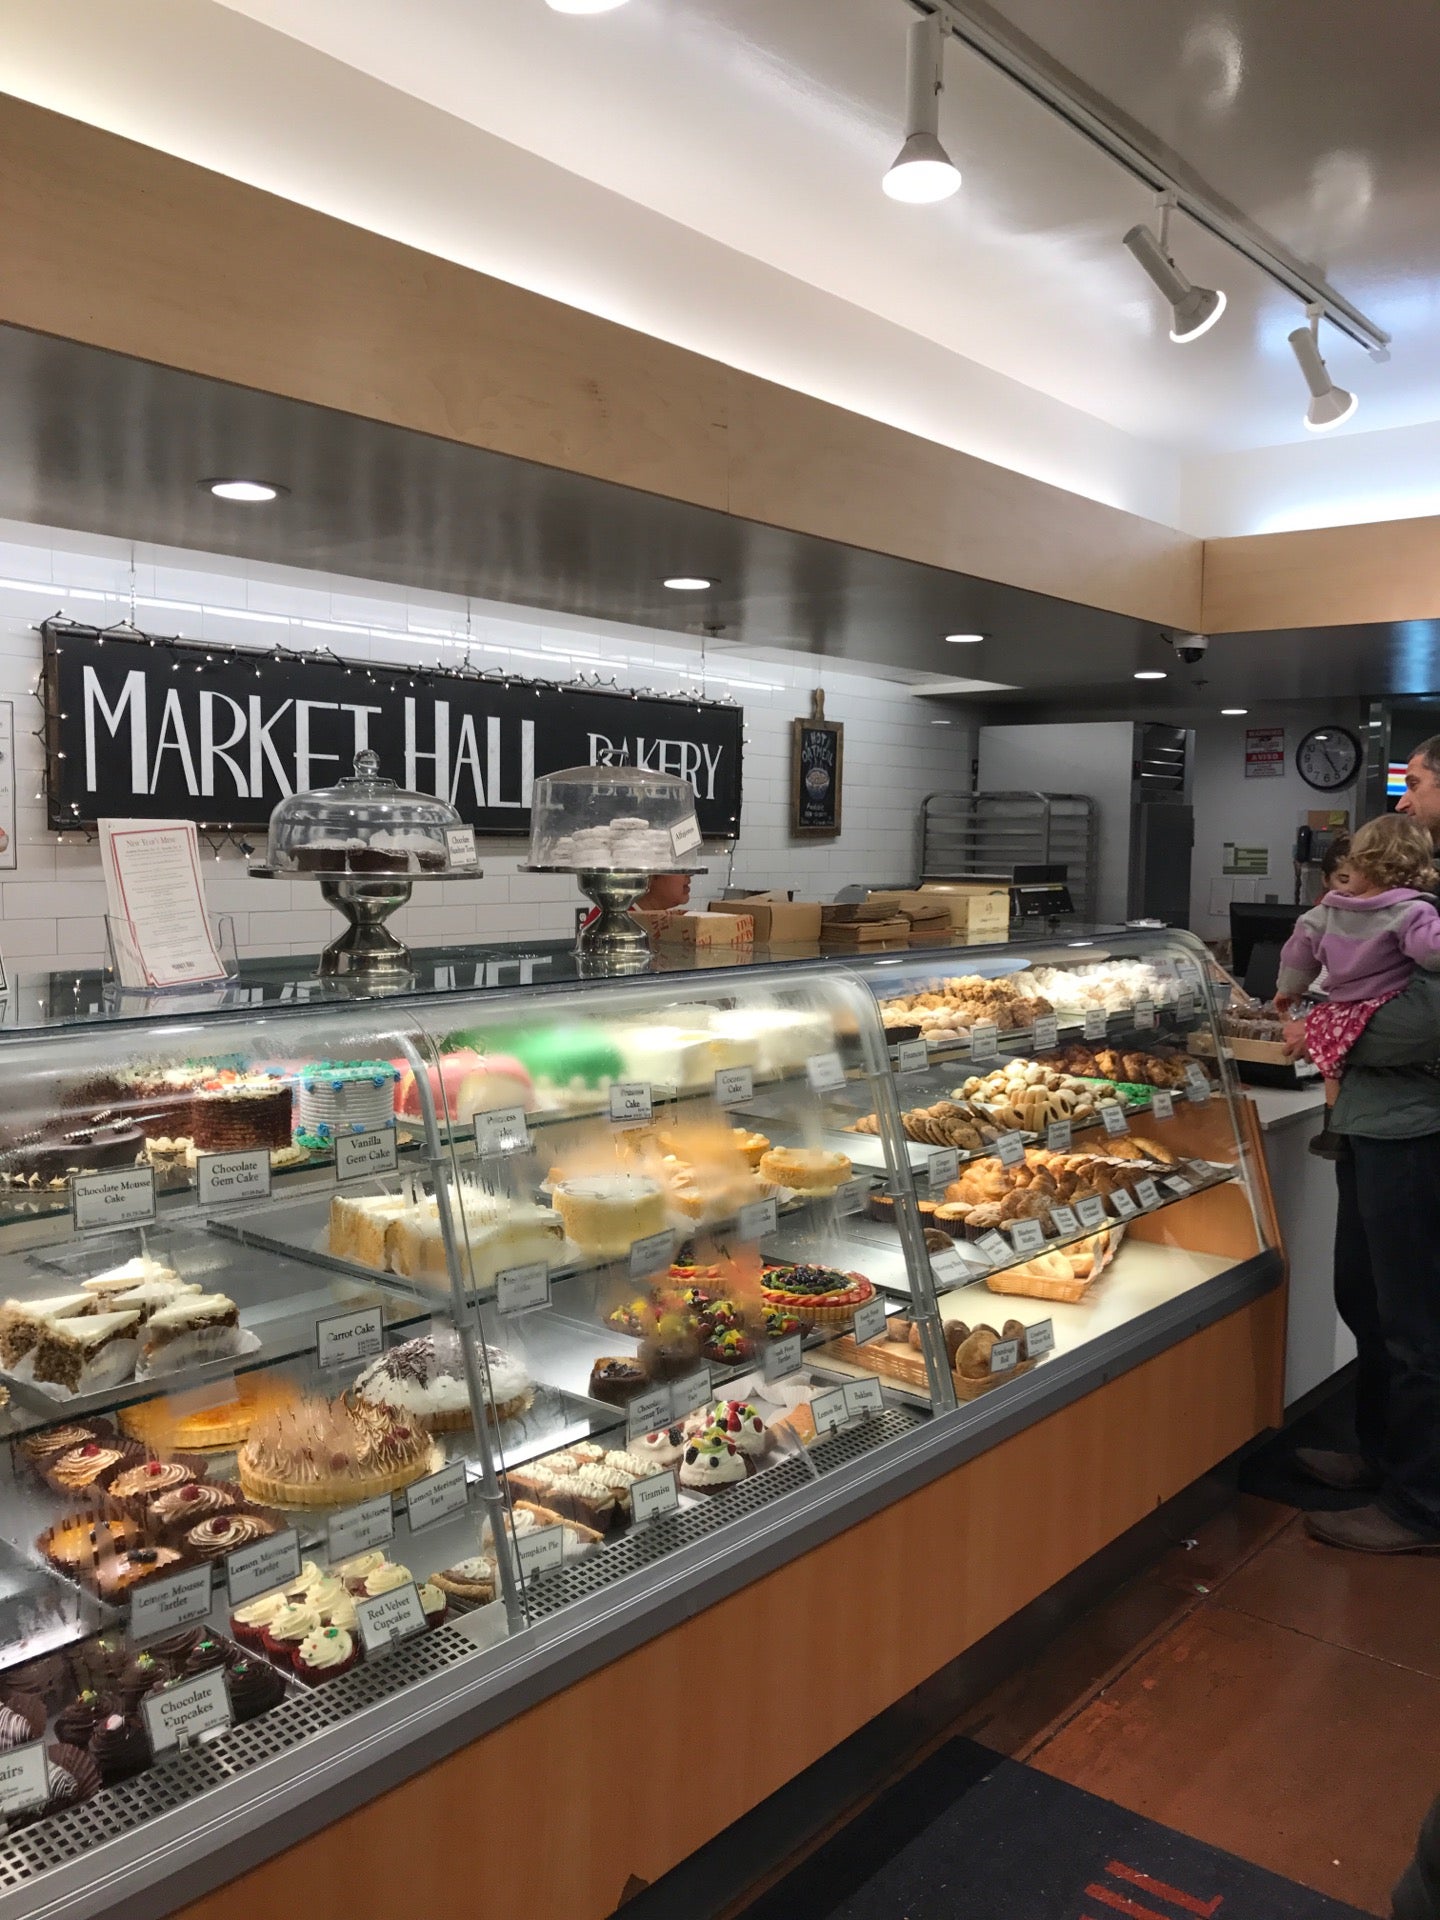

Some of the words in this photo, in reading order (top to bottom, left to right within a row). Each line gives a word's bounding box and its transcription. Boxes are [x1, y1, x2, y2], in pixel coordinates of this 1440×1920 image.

[83, 665, 382, 799] MARKET
[404, 697, 562, 808] HALL
[587, 733, 723, 799] BAKERY
[810, 732, 827, 744] HOT
[727, 1084, 742, 1094] Cake
[625, 1099, 640, 1109] Cake
[350, 1135, 382, 1149] Vanilla
[346, 1152, 368, 1166] Gem
[369, 1149, 391, 1161] Cake
[212, 1161, 258, 1175] Chocolate
[211, 1175, 234, 1187] Gem
[236, 1172, 259, 1184] Cake
[77, 1184, 119, 1198] Chocolate
[120, 1179, 151, 1192] Mousse
[104, 1193, 126, 1205] Cake
[327, 1328, 353, 1342] Carrot
[354, 1323, 376, 1336] Cake
[817, 1408, 834, 1420] Lemon
[433, 1475, 464, 1495] Meringue
[430, 1494, 444, 1506] Tart
[638, 1485, 670, 1503] Tiramisu
[548, 1540, 559, 1551] Pie
[230, 1559, 258, 1576] Lemon
[254, 1560, 280, 1577] Tartlet
[171, 1579, 205, 1597] Mousse
[159, 1595, 188, 1613] Tartlet
[367, 1605, 385, 1621] Red
[385, 1597, 410, 1612] Velvet
[373, 1610, 411, 1632] Cupcakes
[160, 1687, 213, 1716] Chocolate
[164, 1702, 214, 1729] Cupcakes
[0, 1764, 24, 1782] airs
